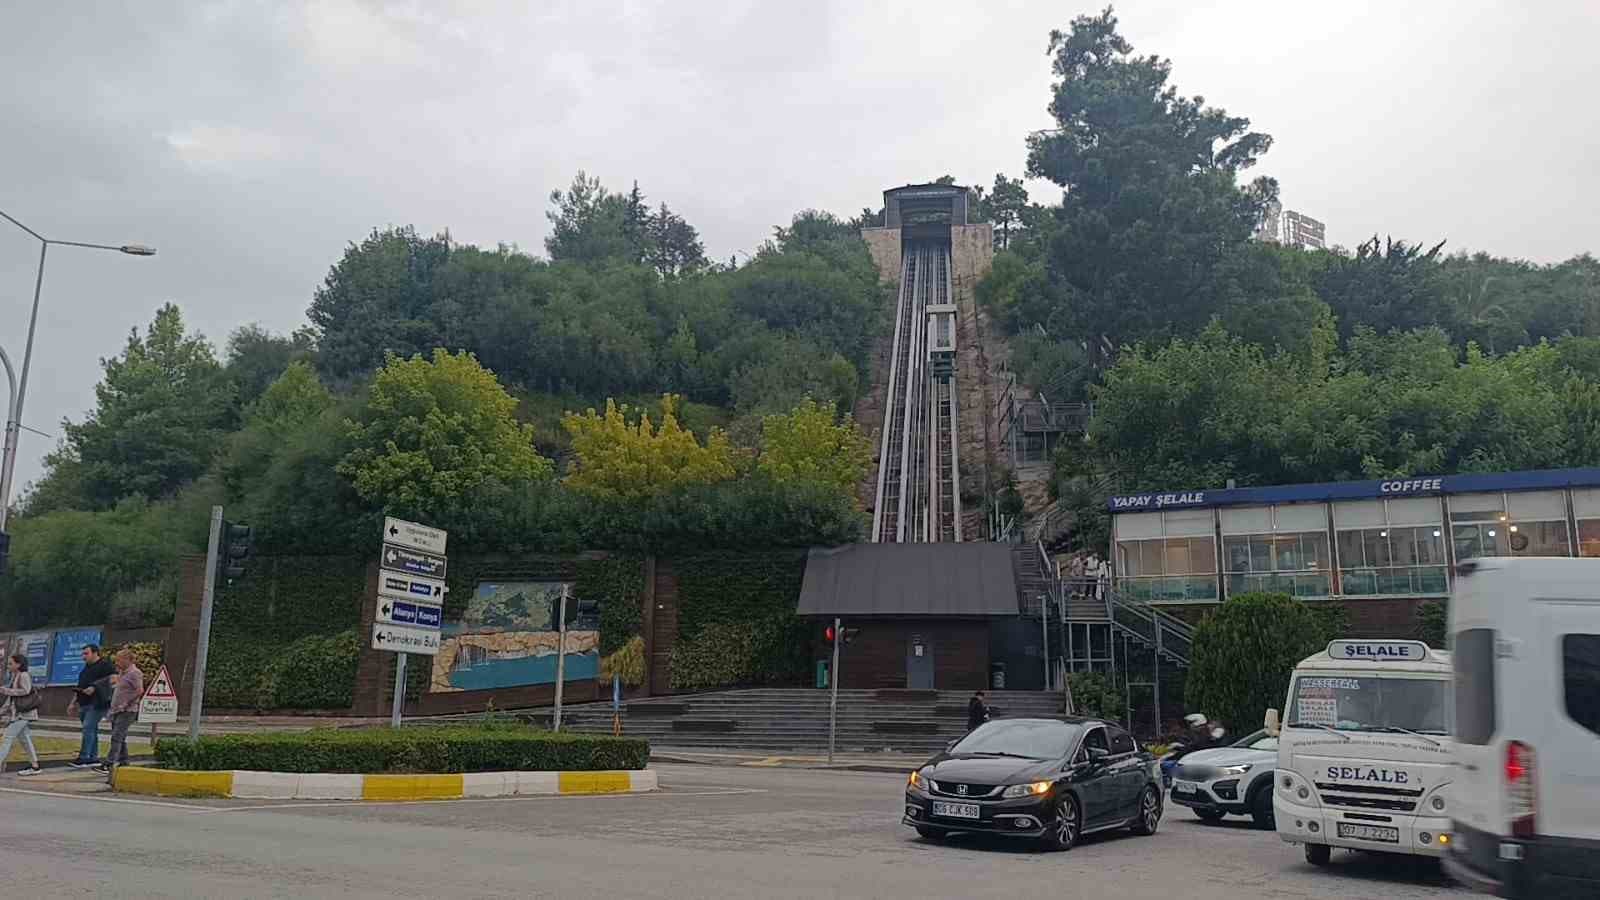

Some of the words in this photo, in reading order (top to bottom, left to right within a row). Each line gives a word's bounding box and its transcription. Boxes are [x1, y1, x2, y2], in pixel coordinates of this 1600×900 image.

[1381, 478, 1442, 493] COFFEE
[1112, 495, 1151, 508] YAPAY
[1155, 492, 1204, 508] ŞELALE
[1345, 645, 1409, 657] ŞELALE
